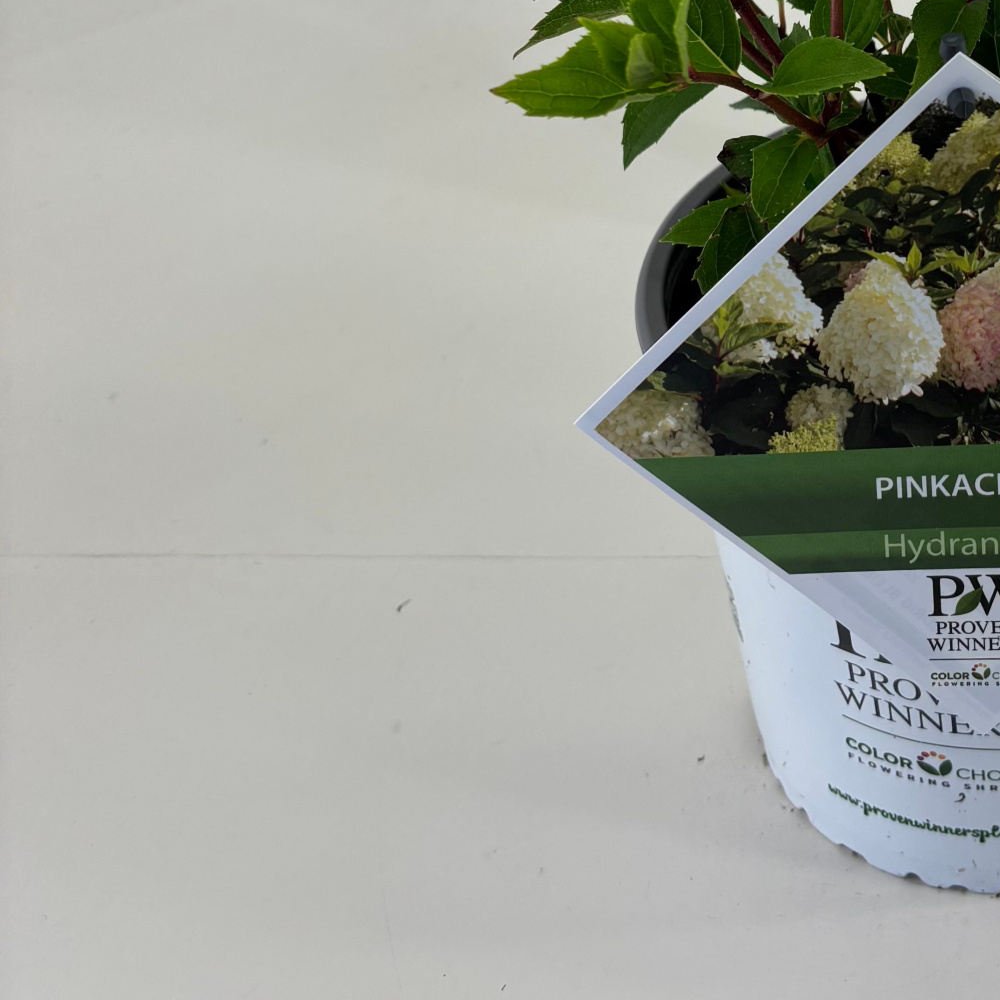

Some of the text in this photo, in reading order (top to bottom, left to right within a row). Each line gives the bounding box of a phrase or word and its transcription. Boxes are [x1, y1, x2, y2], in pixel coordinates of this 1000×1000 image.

[930, 672, 970, 680] COLOR
[845, 736, 914, 770] COLOR
[848, 751, 951, 788] FLOWERING
